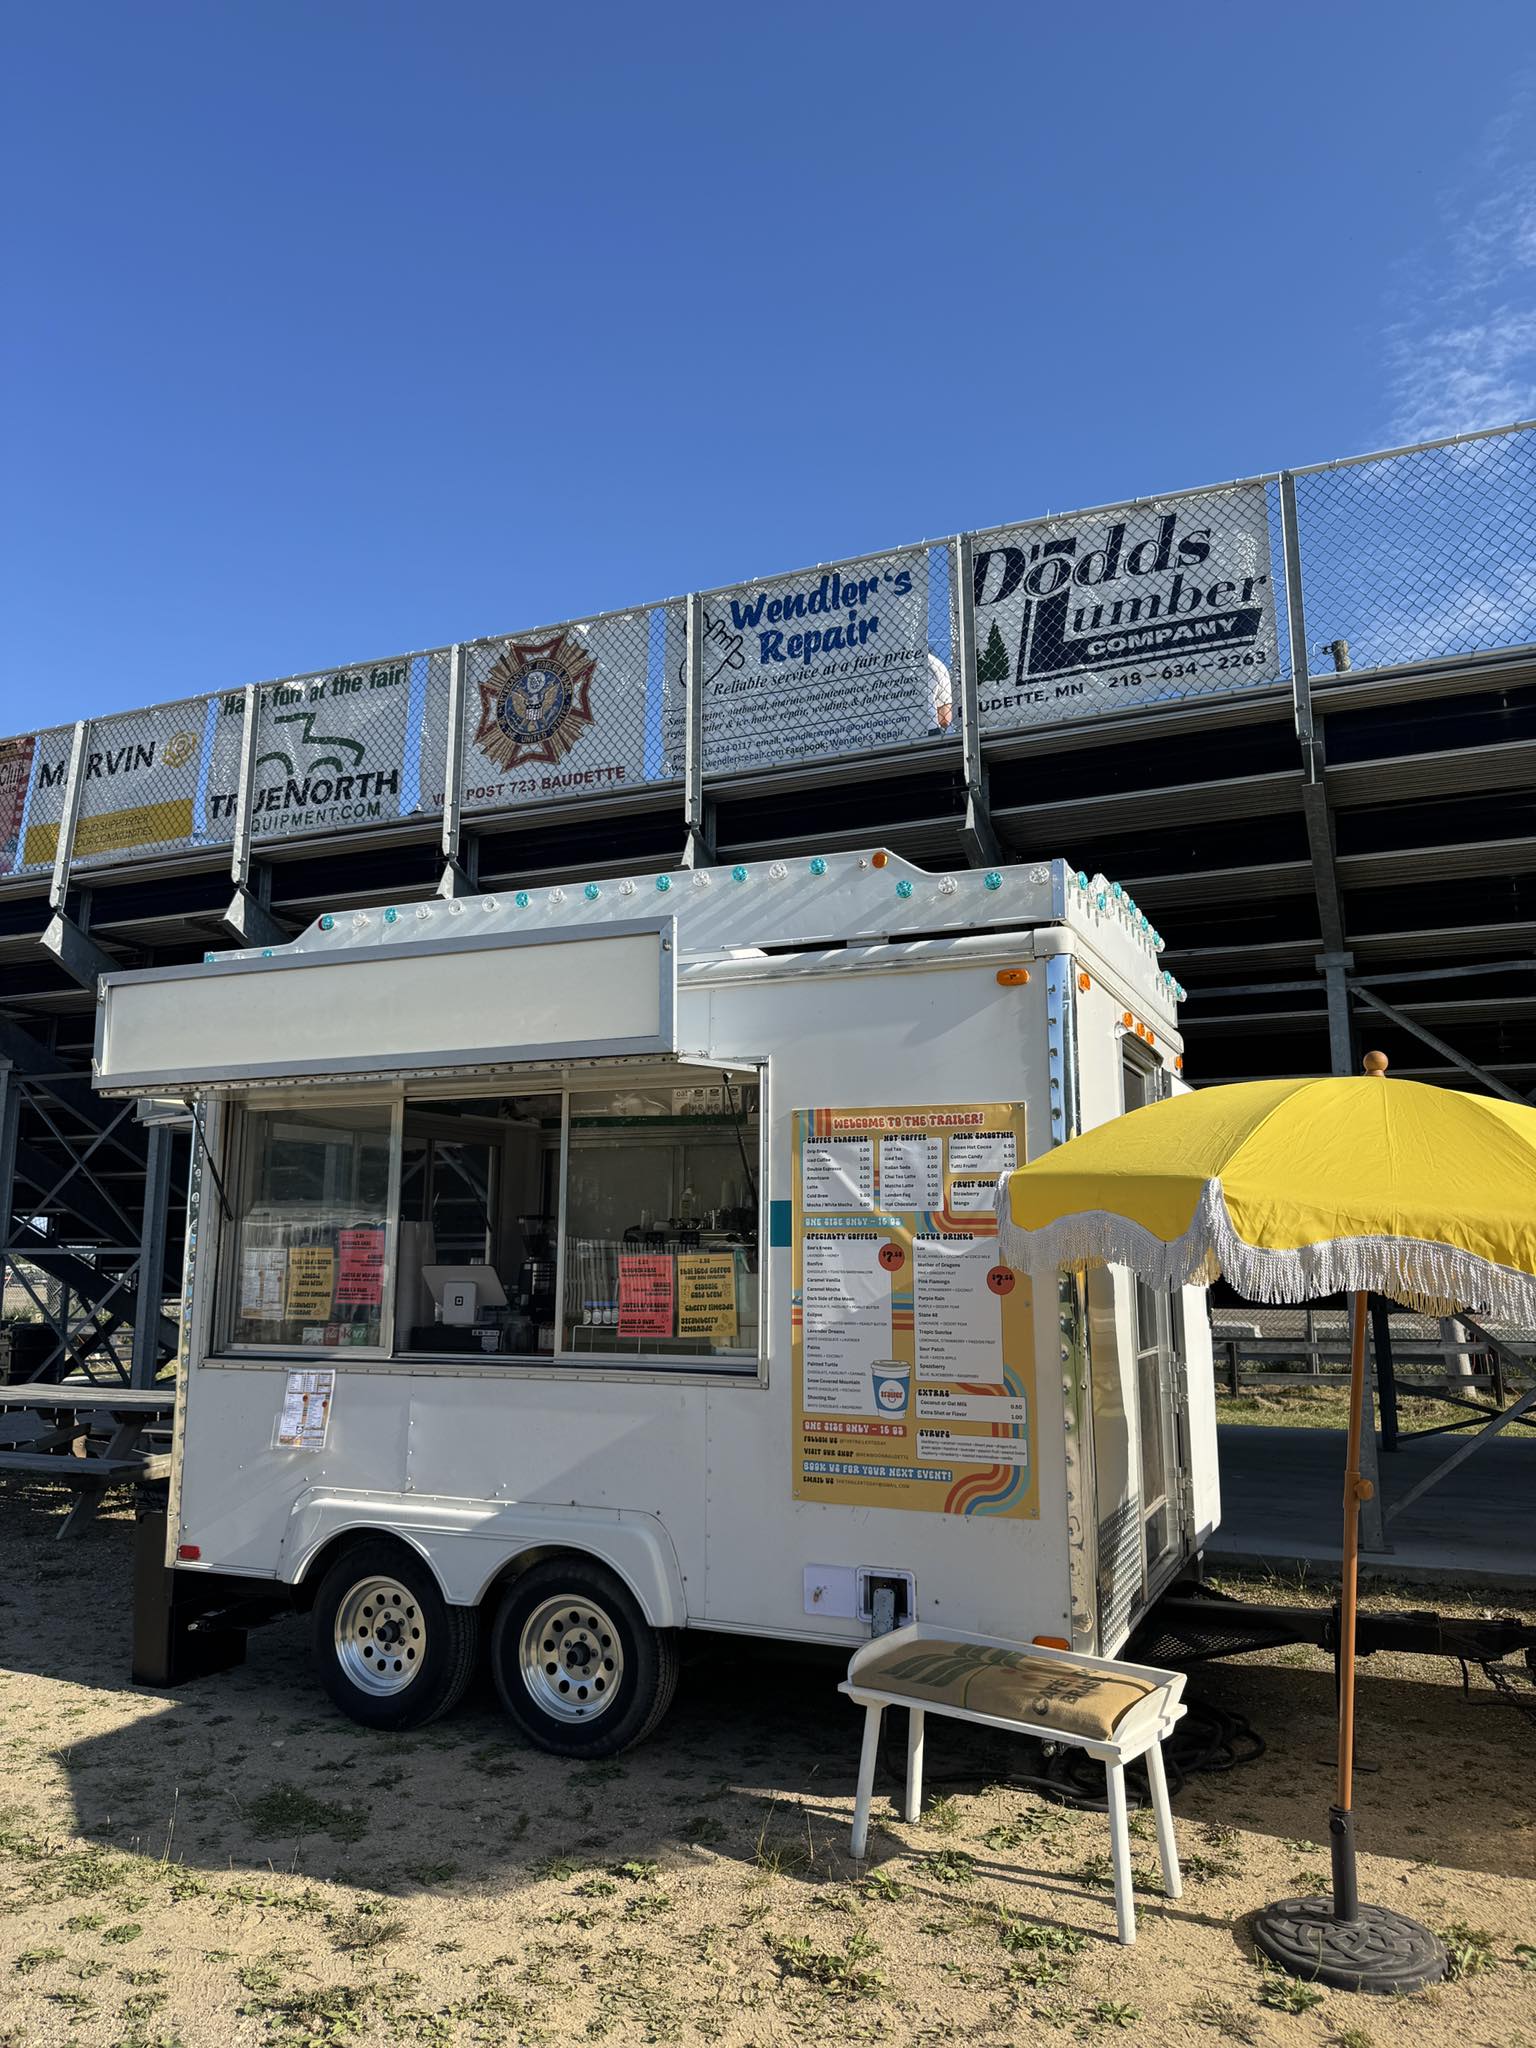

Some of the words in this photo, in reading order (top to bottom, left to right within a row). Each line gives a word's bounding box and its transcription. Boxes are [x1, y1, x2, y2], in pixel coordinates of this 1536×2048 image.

[973, 513, 1212, 608] Dodds
[730, 568, 913, 630] Wendler's
[758, 610, 880, 665] Repair
[1017, 573, 1268, 686] Lumber
[1086, 616, 1237, 656] COMPANY
[713, 677, 768, 696] Reliable
[771, 666, 818, 686] service
[823, 662, 838, 676] at
[840, 661, 849, 672] a
[851, 654, 880, 674] fair
[883, 650, 925, 668] price.
[223, 693, 266, 716] Hae
[273, 686, 302, 707] fun
[309, 682, 327, 703] at
[331, 674, 363, 697] the
[726, 719, 734, 728] &
[813, 702, 849, 715] welding
[851, 697, 861, 707] &
[862, 689, 919, 705] fabrication.
[728, 704, 770, 716] outboard,
[772, 698, 805, 708] marine
[958, 691, 1049, 718] UDETTE,
[1056, 683, 1084, 697] MN
[875, 729, 905, 740] Repair
[38, 741, 157, 790] MRVIN
[466, 784, 506, 801] POST
[509, 780, 537, 794] 723
[541, 766, 626, 790] BAUDETTE
[251, 801, 381, 833] QUIPMENT.COM
[834, 1118, 885, 1130] WELCOME
[887, 1117, 901, 1128] TO
[904, 1116, 926, 1127] THE
[929, 1113, 984, 1127] TRAILER!
[975, 1132, 1014, 1140] SMOOTHIE
[918, 1389, 950, 1398] EXTRAS
[805, 1421, 821, 1431] ONE
[824, 1422, 843, 1432] SIZE
[846, 1423, 870, 1434] ONLY
[880, 1425, 890, 1434] 16
[892, 1426, 904, 1436] OZ
[919, 1430, 950, 1438] SYRUPS
[804, 1448, 821, 1456] VISIT
[838, 1450, 854, 1458] SHOP
[803, 1462, 827, 1471] BOOK
[829, 1463, 840, 1472] US
[843, 1464, 860, 1473] FOR
[862, 1465, 886, 1476] YOUR
[889, 1467, 914, 1478] NEXT
[917, 1469, 952, 1481] EVENT!
[803, 1476, 824, 1484] EMAIL
[825, 1477, 834, 1485] US
